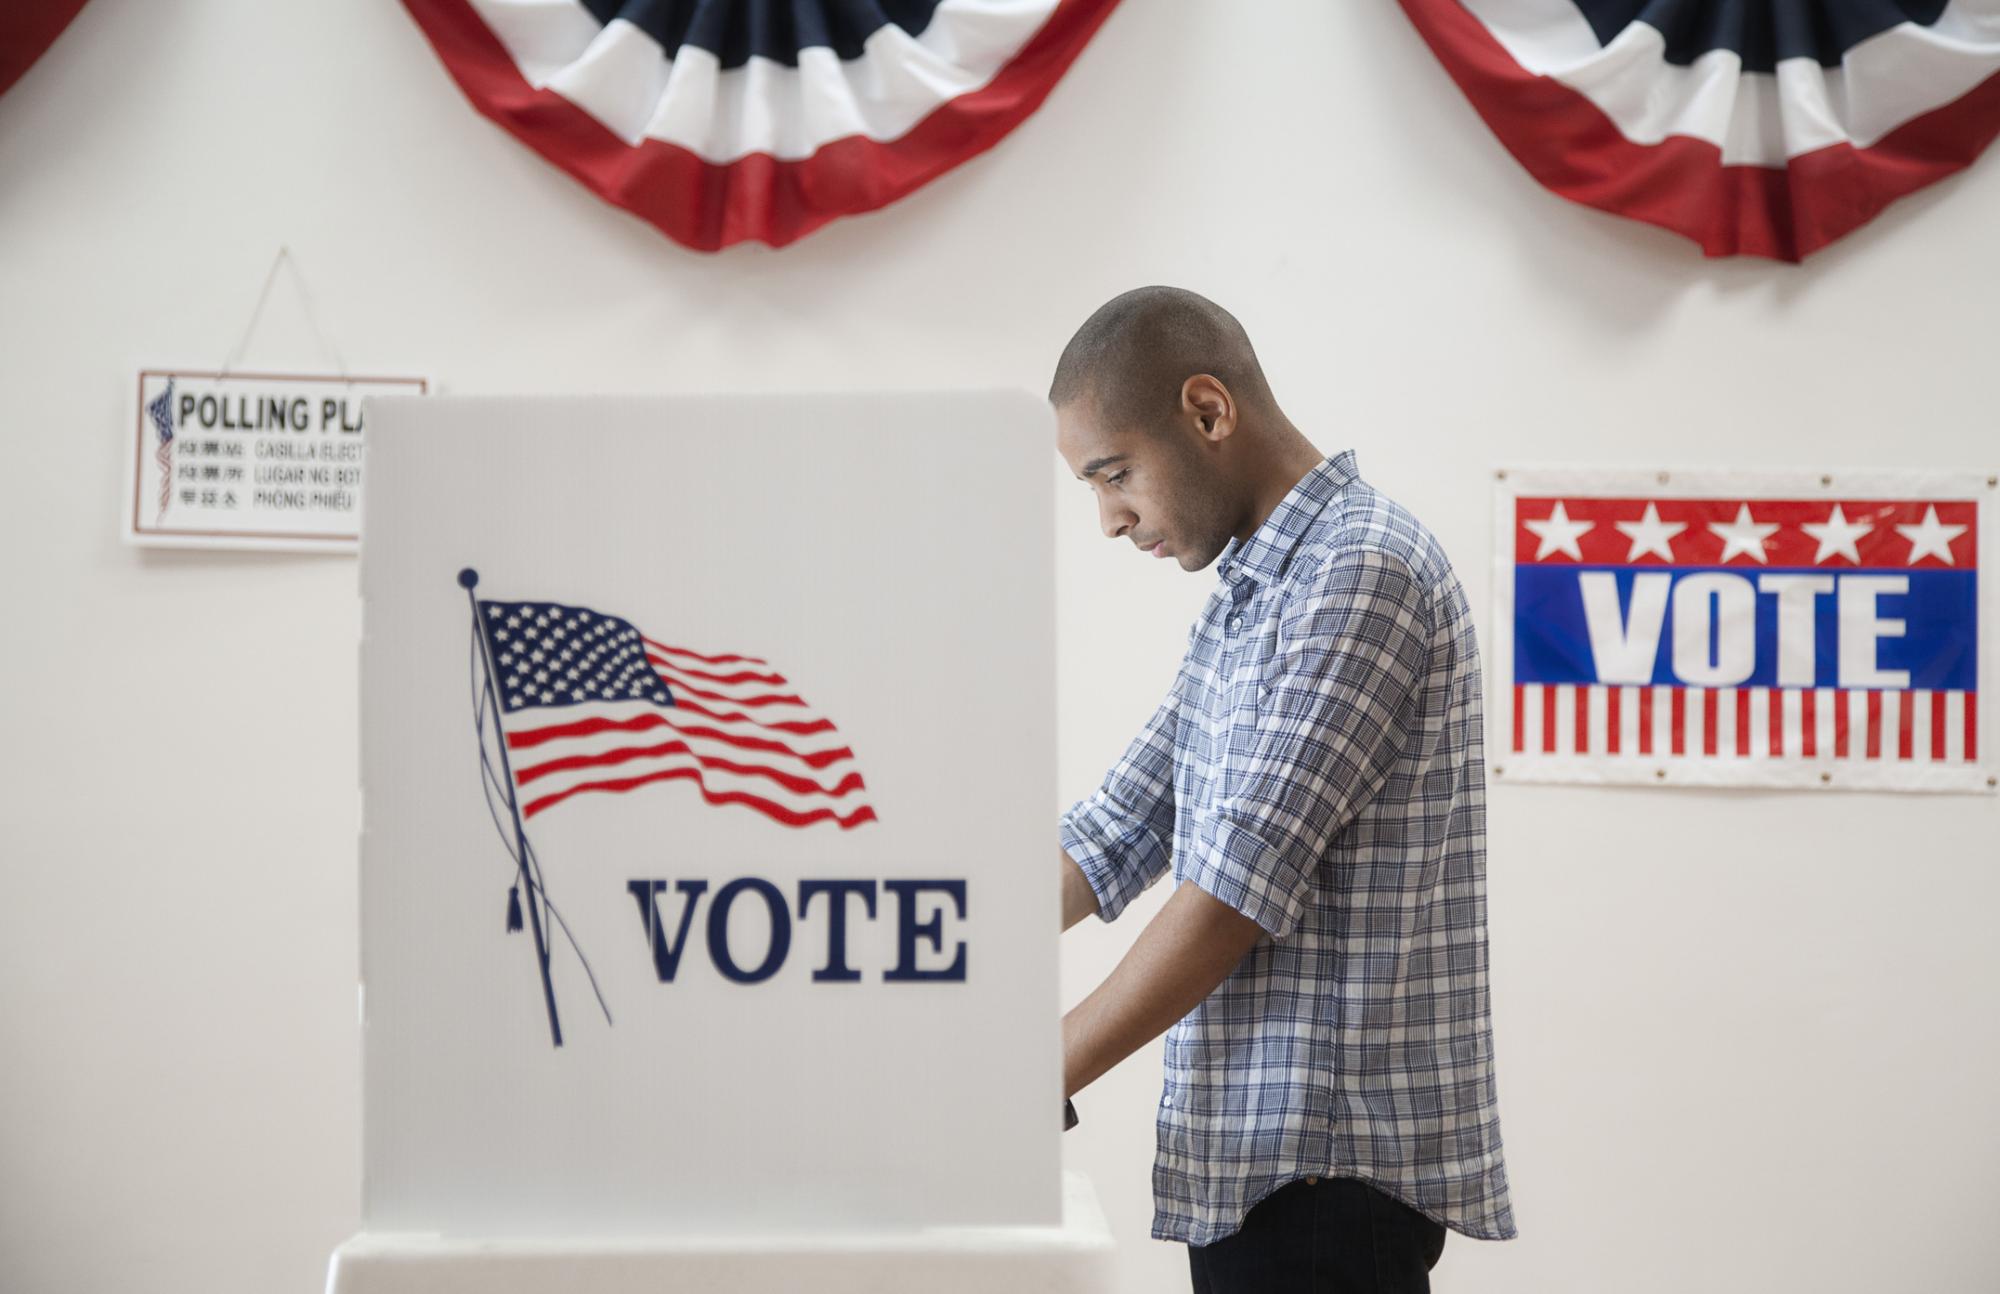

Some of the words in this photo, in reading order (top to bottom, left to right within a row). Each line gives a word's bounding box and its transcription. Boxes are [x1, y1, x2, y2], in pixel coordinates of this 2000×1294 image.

[179, 394, 309, 433] POLLING
[255, 440, 315, 460] CASILLA
[254, 465, 305, 485] LUGAR
[1578, 571, 1911, 688] VOTE
[627, 877, 967, 985] VOTE
